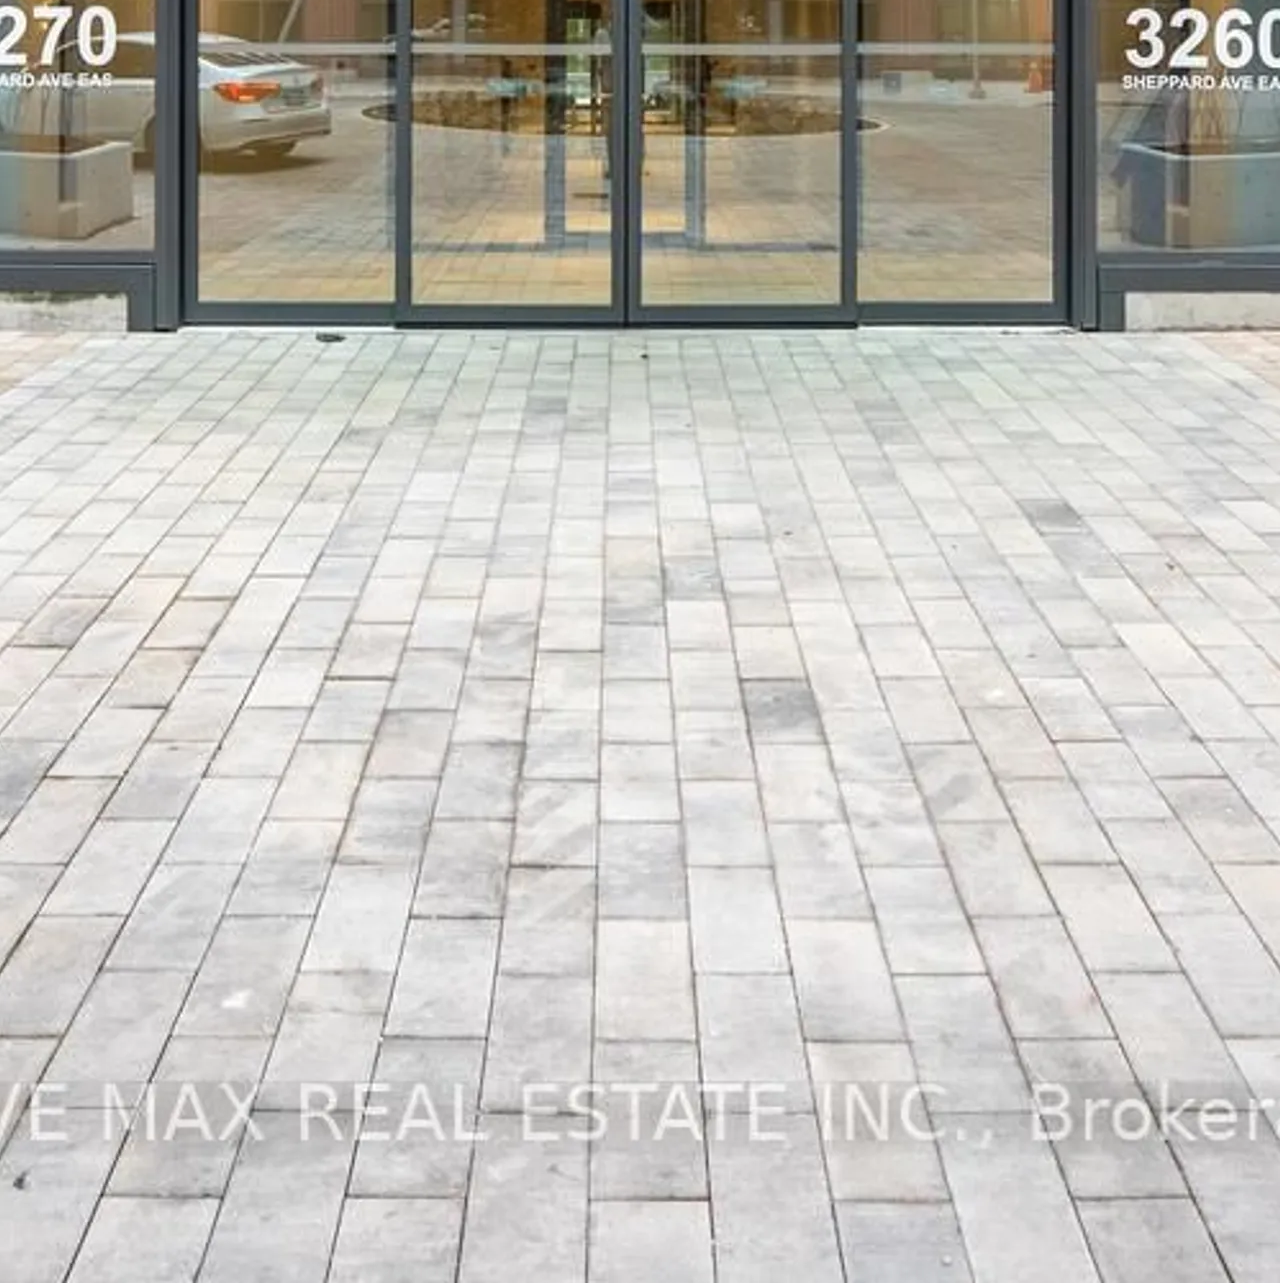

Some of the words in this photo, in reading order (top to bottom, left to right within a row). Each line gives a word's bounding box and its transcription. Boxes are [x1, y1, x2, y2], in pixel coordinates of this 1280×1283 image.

[37, 72, 74, 88] AVE
[1122, 74, 1216, 89] SHEPPARD
[1221, 74, 1253, 90] AVE
